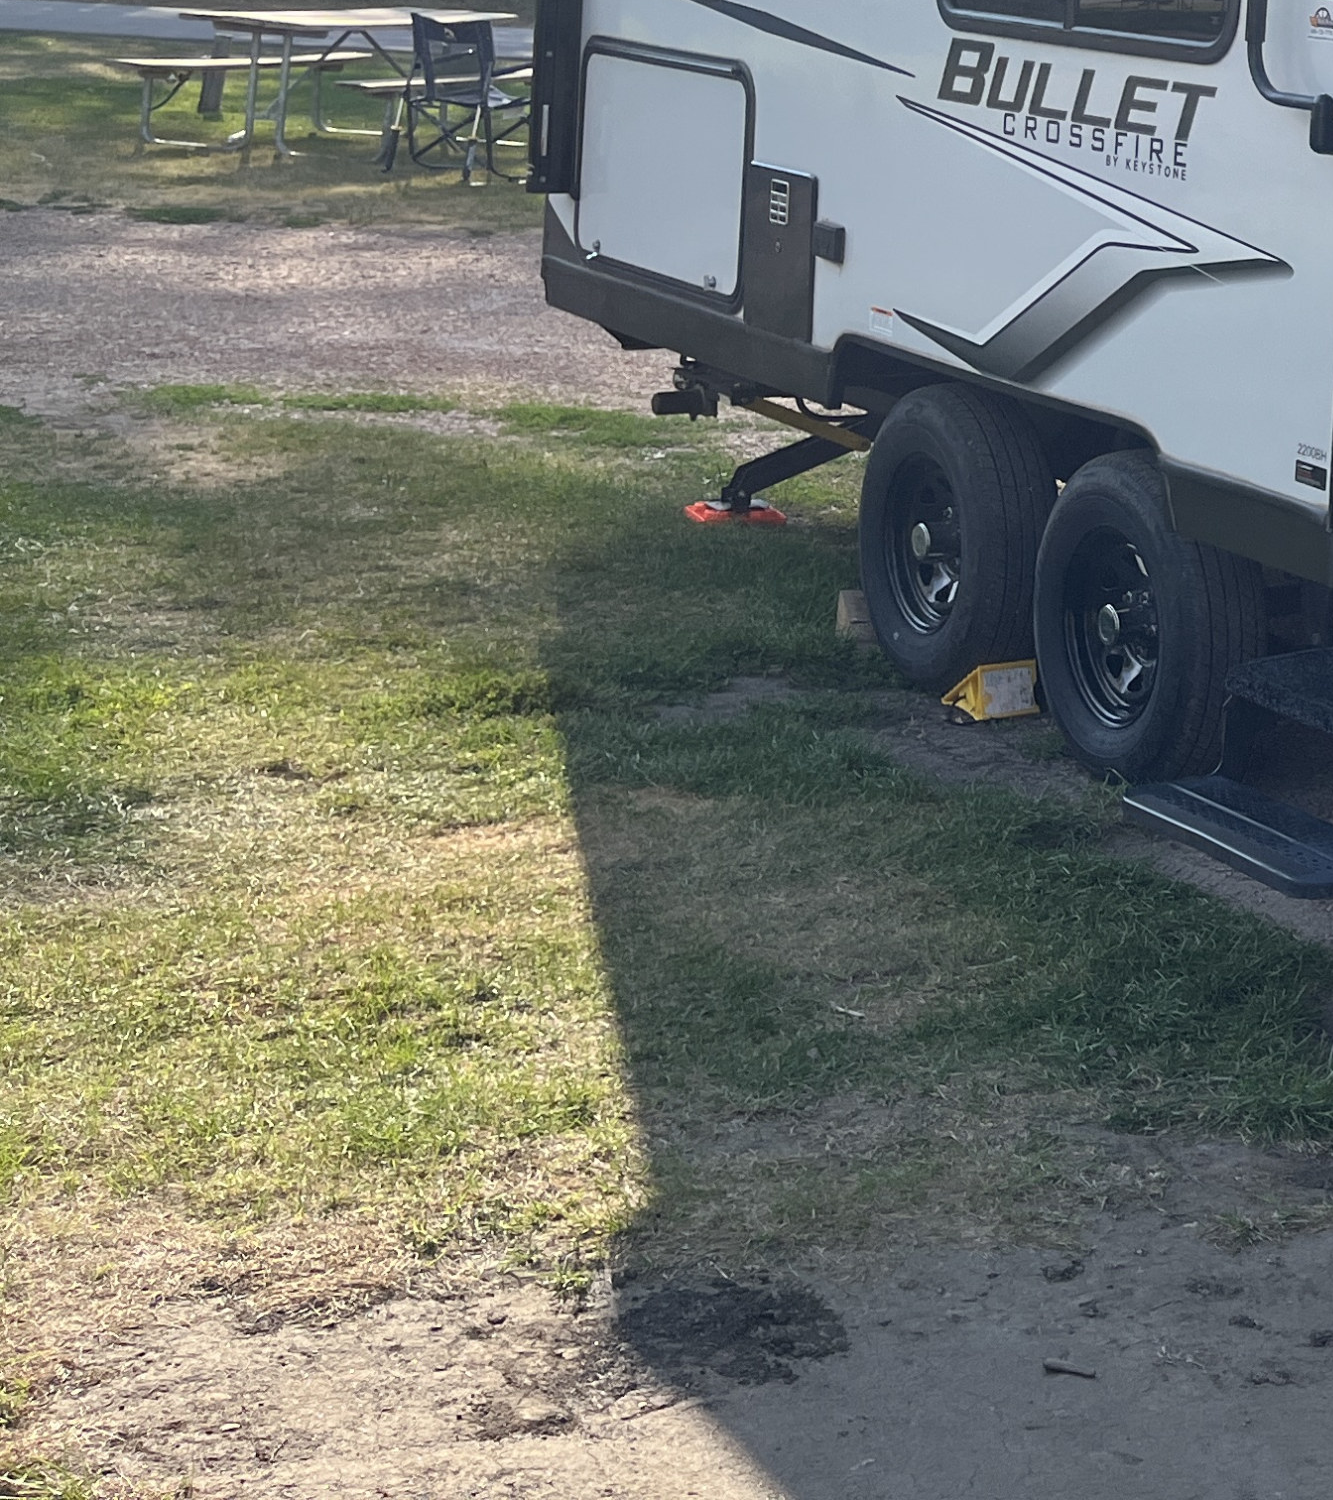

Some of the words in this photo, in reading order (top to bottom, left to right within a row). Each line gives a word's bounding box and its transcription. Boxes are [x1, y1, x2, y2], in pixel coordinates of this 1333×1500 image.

[937, 37, 1218, 142] BULLET
[1003, 112, 1188, 168] CROSSFIRE
[1106, 154, 1119, 167] BY
[1125, 157, 1187, 181] KEYSTONE
